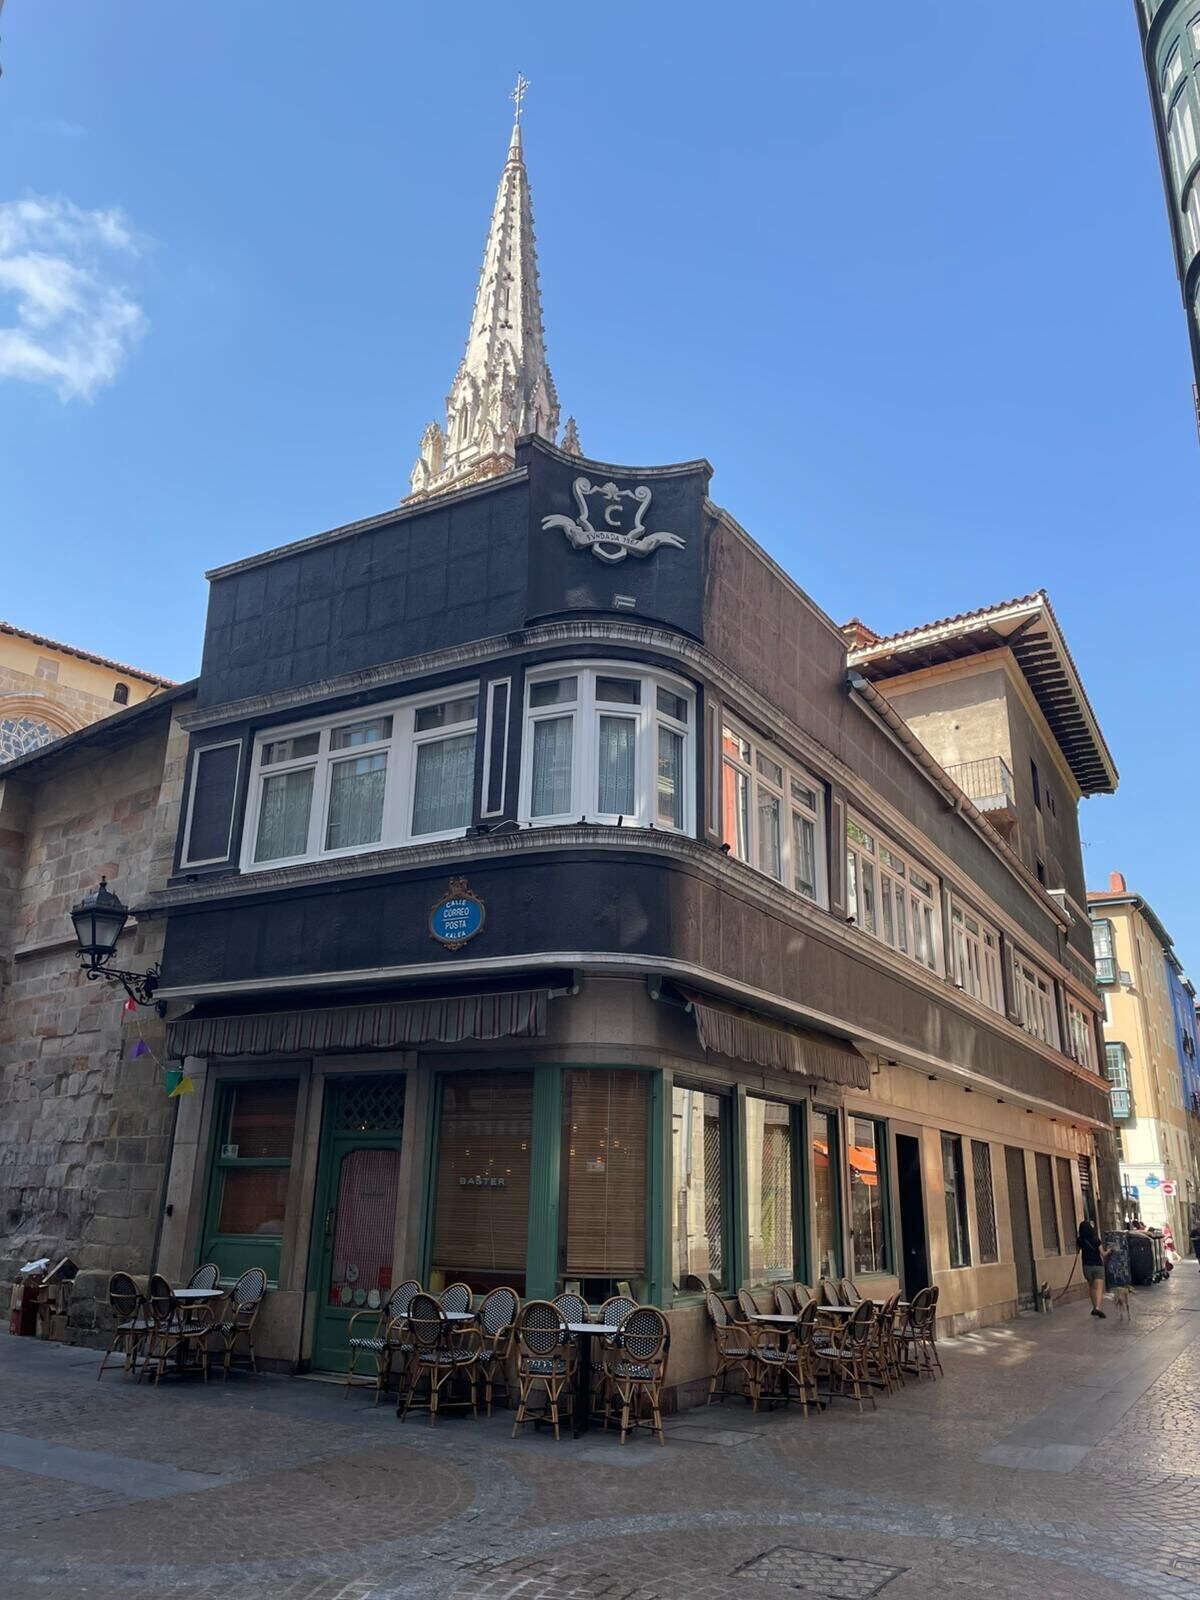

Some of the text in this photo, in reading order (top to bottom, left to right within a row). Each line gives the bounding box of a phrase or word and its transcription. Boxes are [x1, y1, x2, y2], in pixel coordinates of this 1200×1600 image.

[604, 504, 623, 526] C
[445, 899, 467, 909] CALLE
[443, 907, 469, 918] CORREO
[445, 920, 467, 930] POSTA
[445, 931, 466, 939] KALEA
[459, 1176, 505, 1186] BASTER
